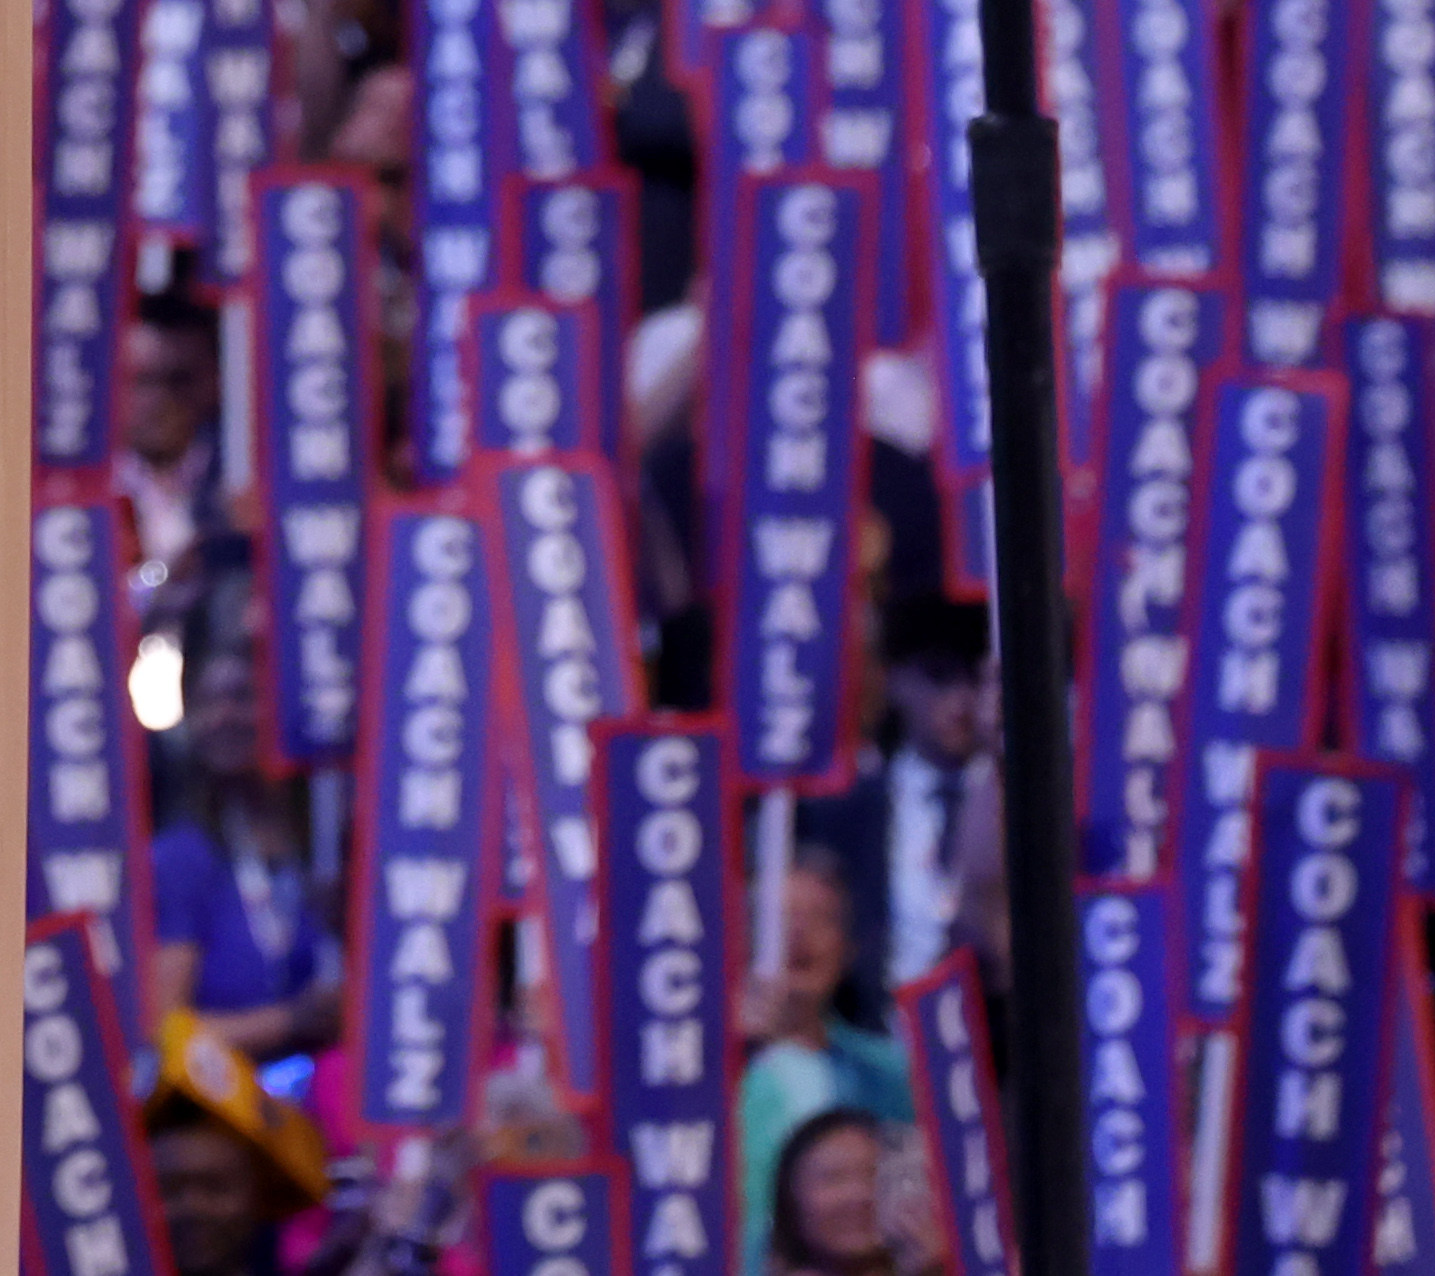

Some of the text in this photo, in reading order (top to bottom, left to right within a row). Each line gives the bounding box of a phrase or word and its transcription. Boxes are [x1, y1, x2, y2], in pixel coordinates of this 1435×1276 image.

[39, 221, 116, 456] WALZ
[281, 185, 361, 742] COACH WALZ
[748, 183, 837, 764] COACH WALZ
[1126, 287, 1201, 606] COACH
[1358, 318, 1418, 615] COACH
[35, 505, 110, 822] COACH
[1222, 386, 1302, 715] COACH
[385, 516, 474, 1109] COACH WALZ
[636, 739, 705, 1086] COACH
[1272, 776, 1362, 1140] COACH
[24, 941, 128, 1276] COACH
[1083, 897, 1147, 1247] COACH
